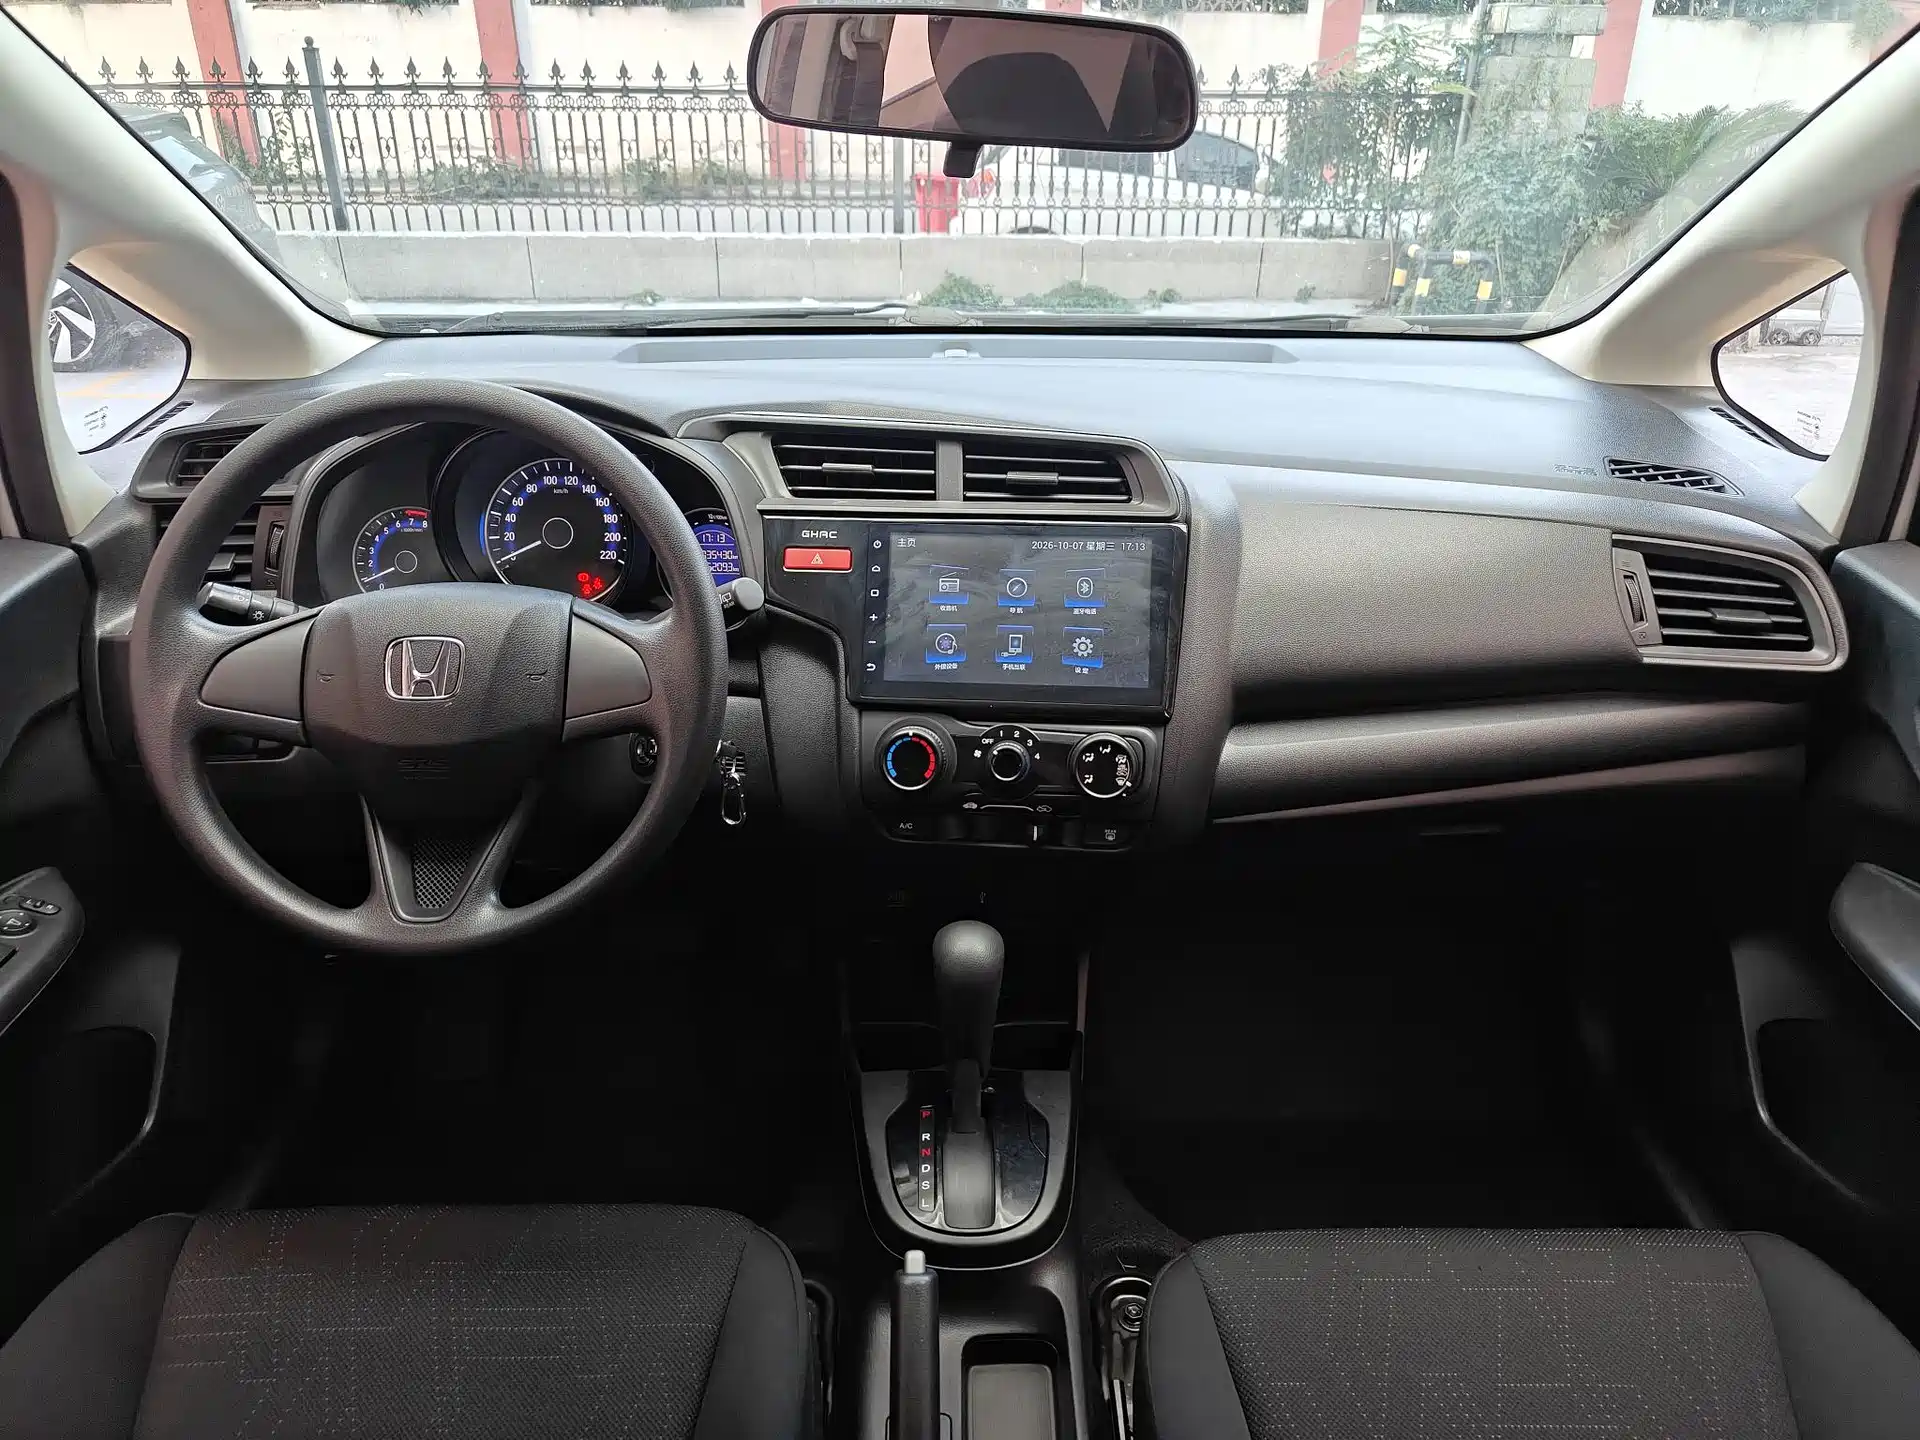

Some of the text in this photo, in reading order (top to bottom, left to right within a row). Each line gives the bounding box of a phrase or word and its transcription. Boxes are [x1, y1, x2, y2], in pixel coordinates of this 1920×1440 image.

[543, 475, 558, 486] 100
[563, 475, 579, 486] 120
[525, 484, 538, 494] 80
[581, 484, 597, 494] 140
[511, 497, 524, 507] 60
[595, 497, 610, 507] 160
[408, 517, 415, 526] 7
[504, 513, 517, 523] 40
[603, 513, 618, 524] 180
[395, 520, 401, 528] 6
[422, 520, 428, 529] 8
[383, 526, 389, 535] 5
[801, 529, 838, 539] GHAC
[374, 534, 380, 542] 4
[503, 532, 516, 542] 20
[604, 532, 621, 542] 200
[702, 533, 726, 543] 17:13
[896, 537, 916, 548] 主页
[1031, 541, 1146, 551] 2026-10-07 星期三 17:13
[369, 547, 375, 555] 3
[599, 550, 617, 560] 220
[368, 560, 374, 568] 2
[1013, 730, 1020, 738] 2
[1026, 739, 1033, 747] 3
[1034, 752, 1040, 760] 4
[922, 1133, 930, 1141] R
[921, 1164, 931, 1173] D
[921, 1181, 930, 1190] S
[922, 1199, 929, 1207] L
